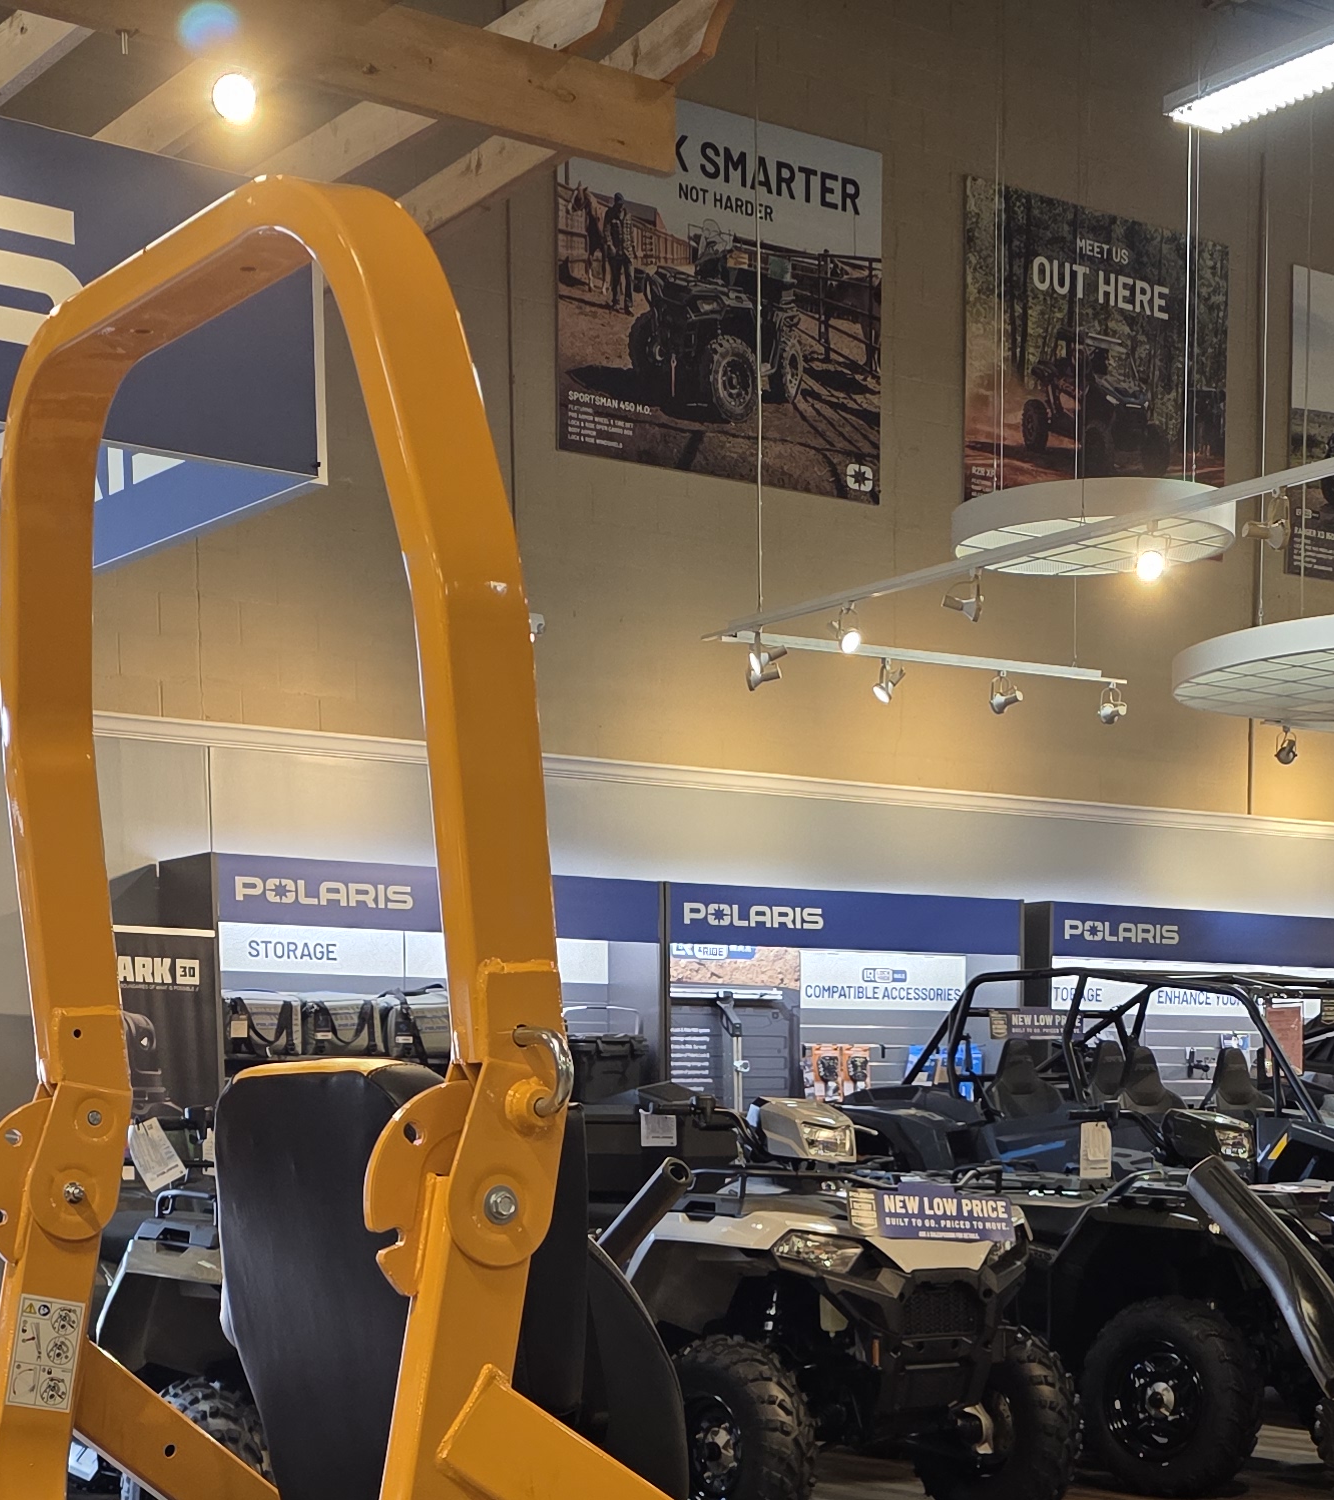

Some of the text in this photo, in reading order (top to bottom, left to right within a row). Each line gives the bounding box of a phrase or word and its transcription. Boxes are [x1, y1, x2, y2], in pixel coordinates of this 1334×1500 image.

[700, 141, 860, 215] SMARTER
[678, 182, 773, 222] NOT HARDER
[1077, 237, 1129, 265] MEET US
[1033, 255, 1169, 320] OUT HERE
[568, 390, 618, 409] SPORTSMAN
[619, 401, 635, 412] 450
[235, 876, 414, 911] POLARIS
[683, 902, 824, 930] POLARIS
[1064, 919, 1180, 945] POLARIS
[248, 939, 338, 962] STORAGE
[117, 956, 173, 984] ARK
[805, 984, 962, 1002] COMPATIBLE ACCESSORIES
[1156, 989, 1212, 1006] ENHANCE
[1011, 1014, 1032, 1026] NEW
[1033, 1014, 1054, 1026] LOW
[1055, 1015, 1082, 1027] PRE
[883, 1194, 920, 1215] NEW
[922, 1196, 958, 1216] LOW
[961, 1199, 1009, 1219] PRICE
[885, 1216, 909, 1226] BUILT
[911, 1218, 923, 1227] TO
[940, 1219, 971, 1229] PRICED
[972, 1220, 984, 1230] TO
[985, 1221, 1010, 1231] MOVE.
